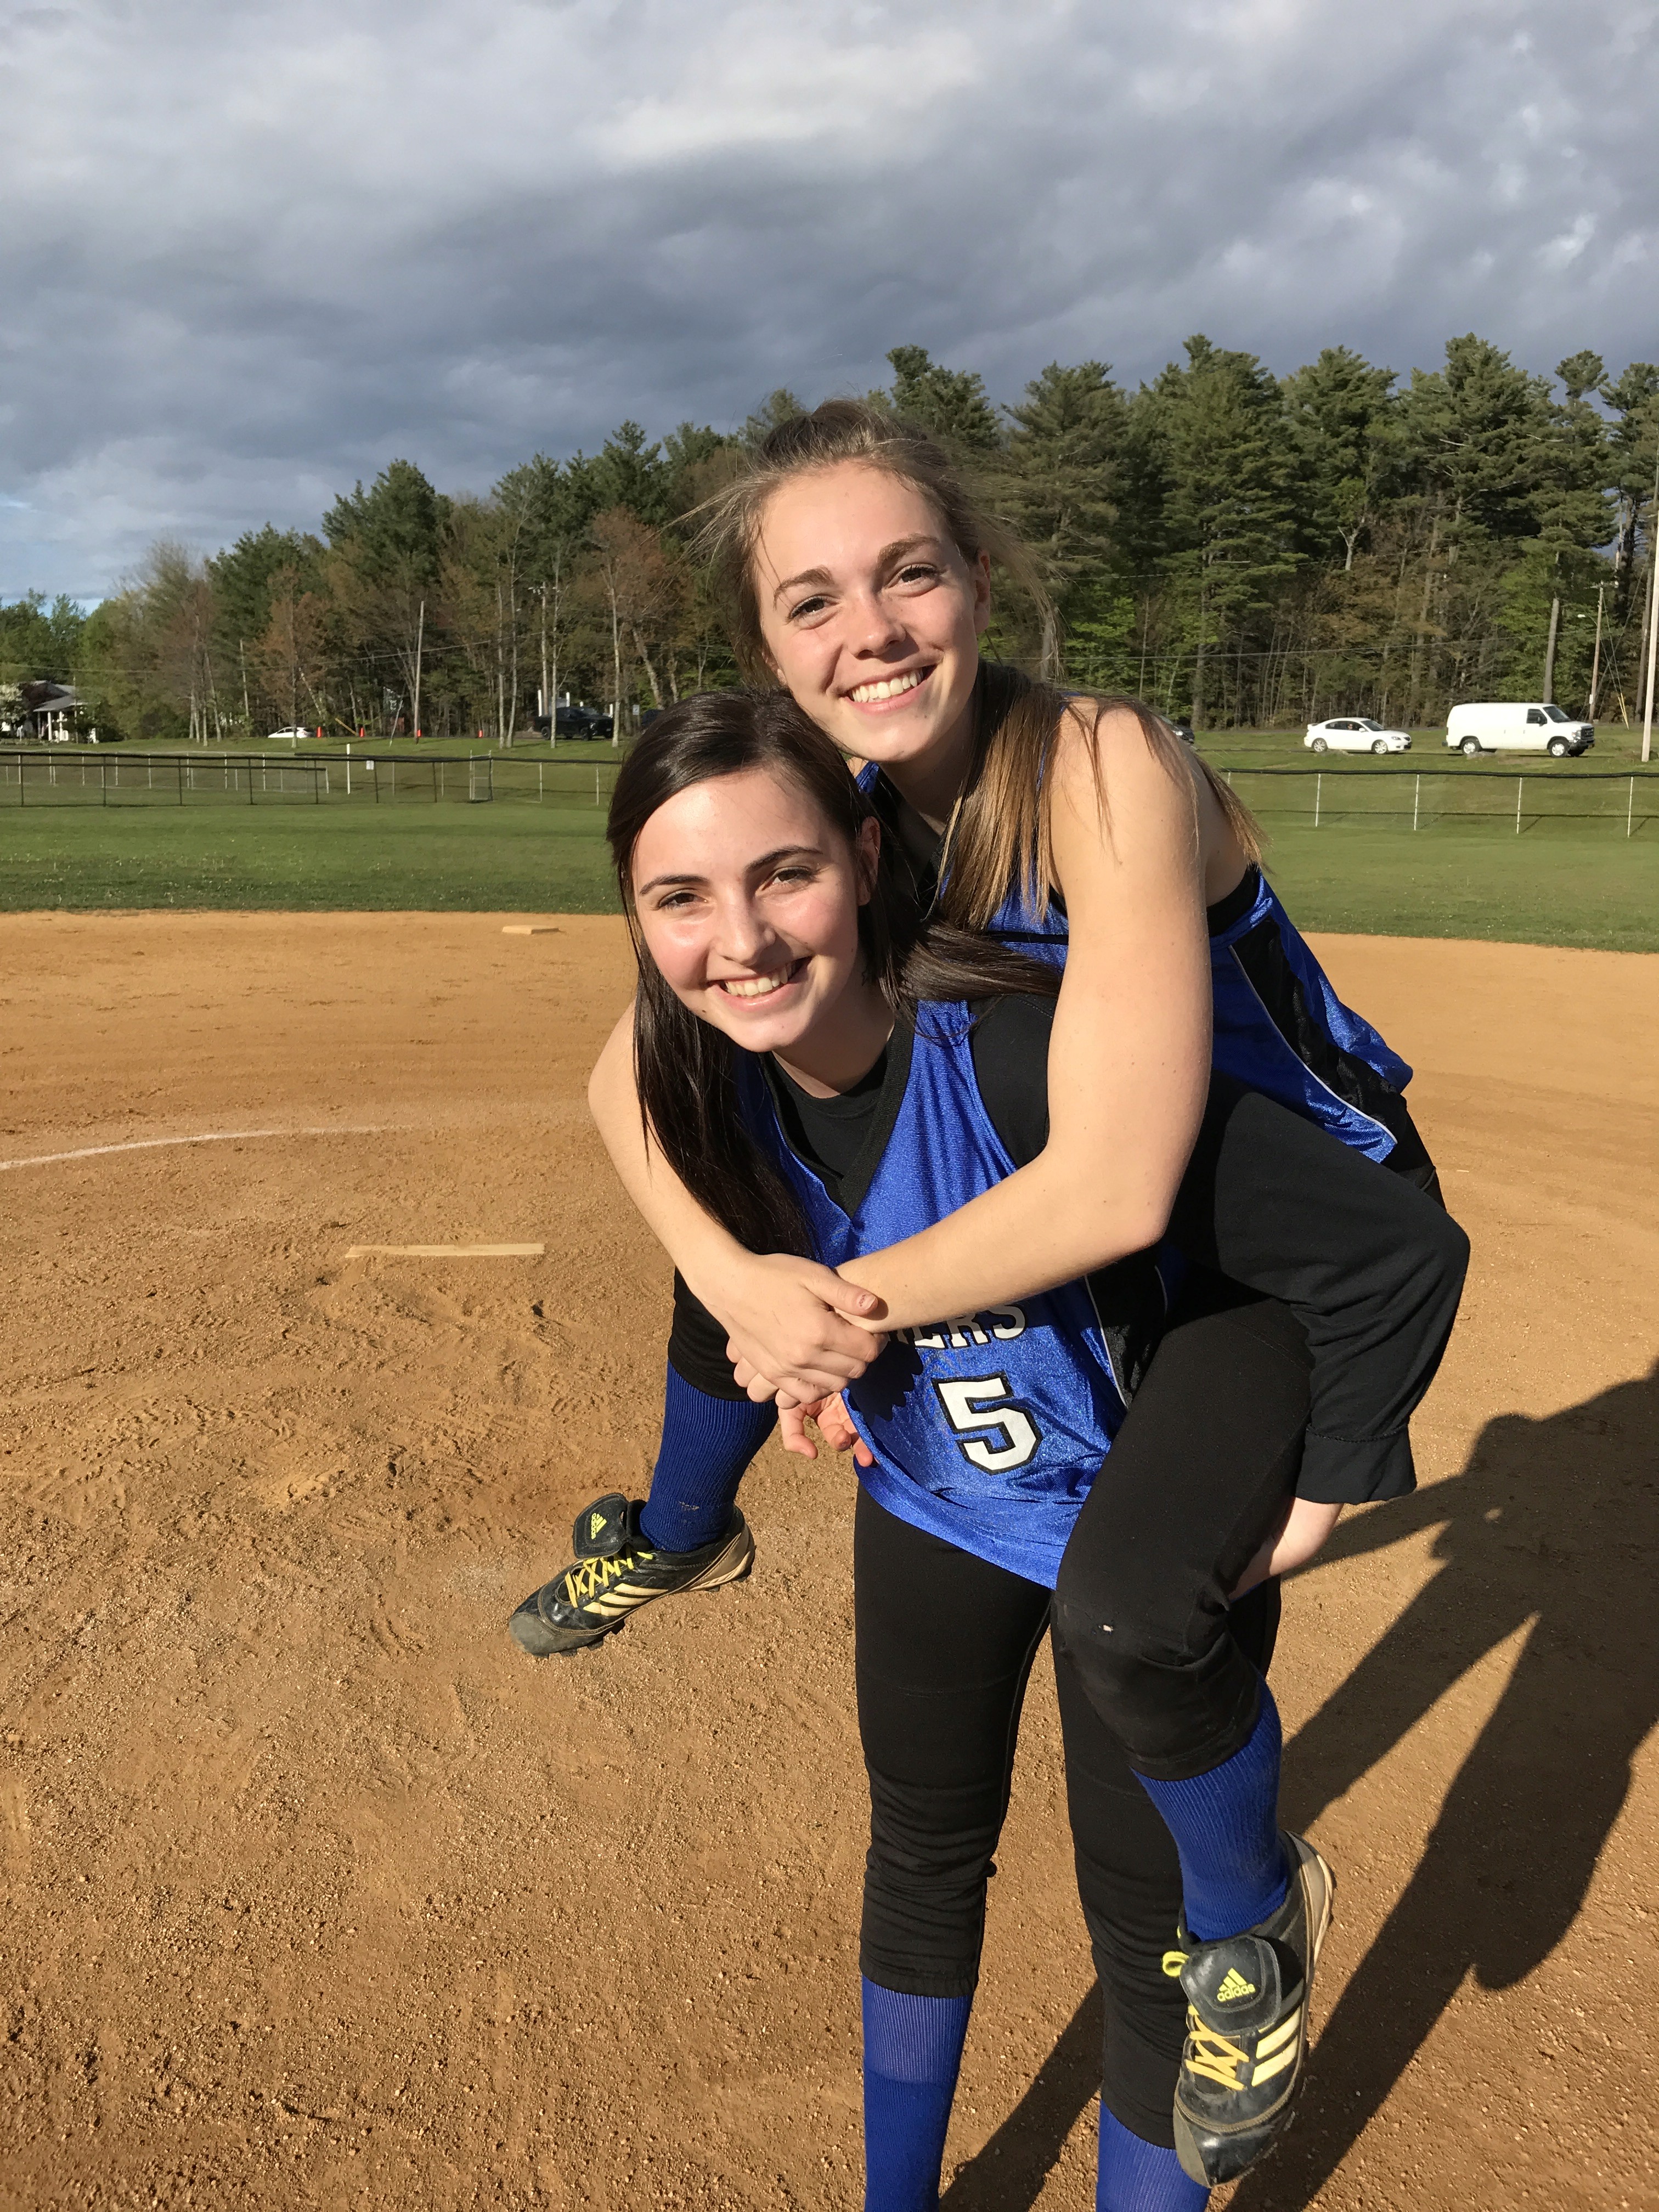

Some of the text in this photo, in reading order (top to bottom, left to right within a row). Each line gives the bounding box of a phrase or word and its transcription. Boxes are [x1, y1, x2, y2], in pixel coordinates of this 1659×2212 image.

[888, 1305, 1026, 1349] ERS
[932, 1372, 1041, 1474] 5
[1217, 1983, 1255, 2002] adidas
